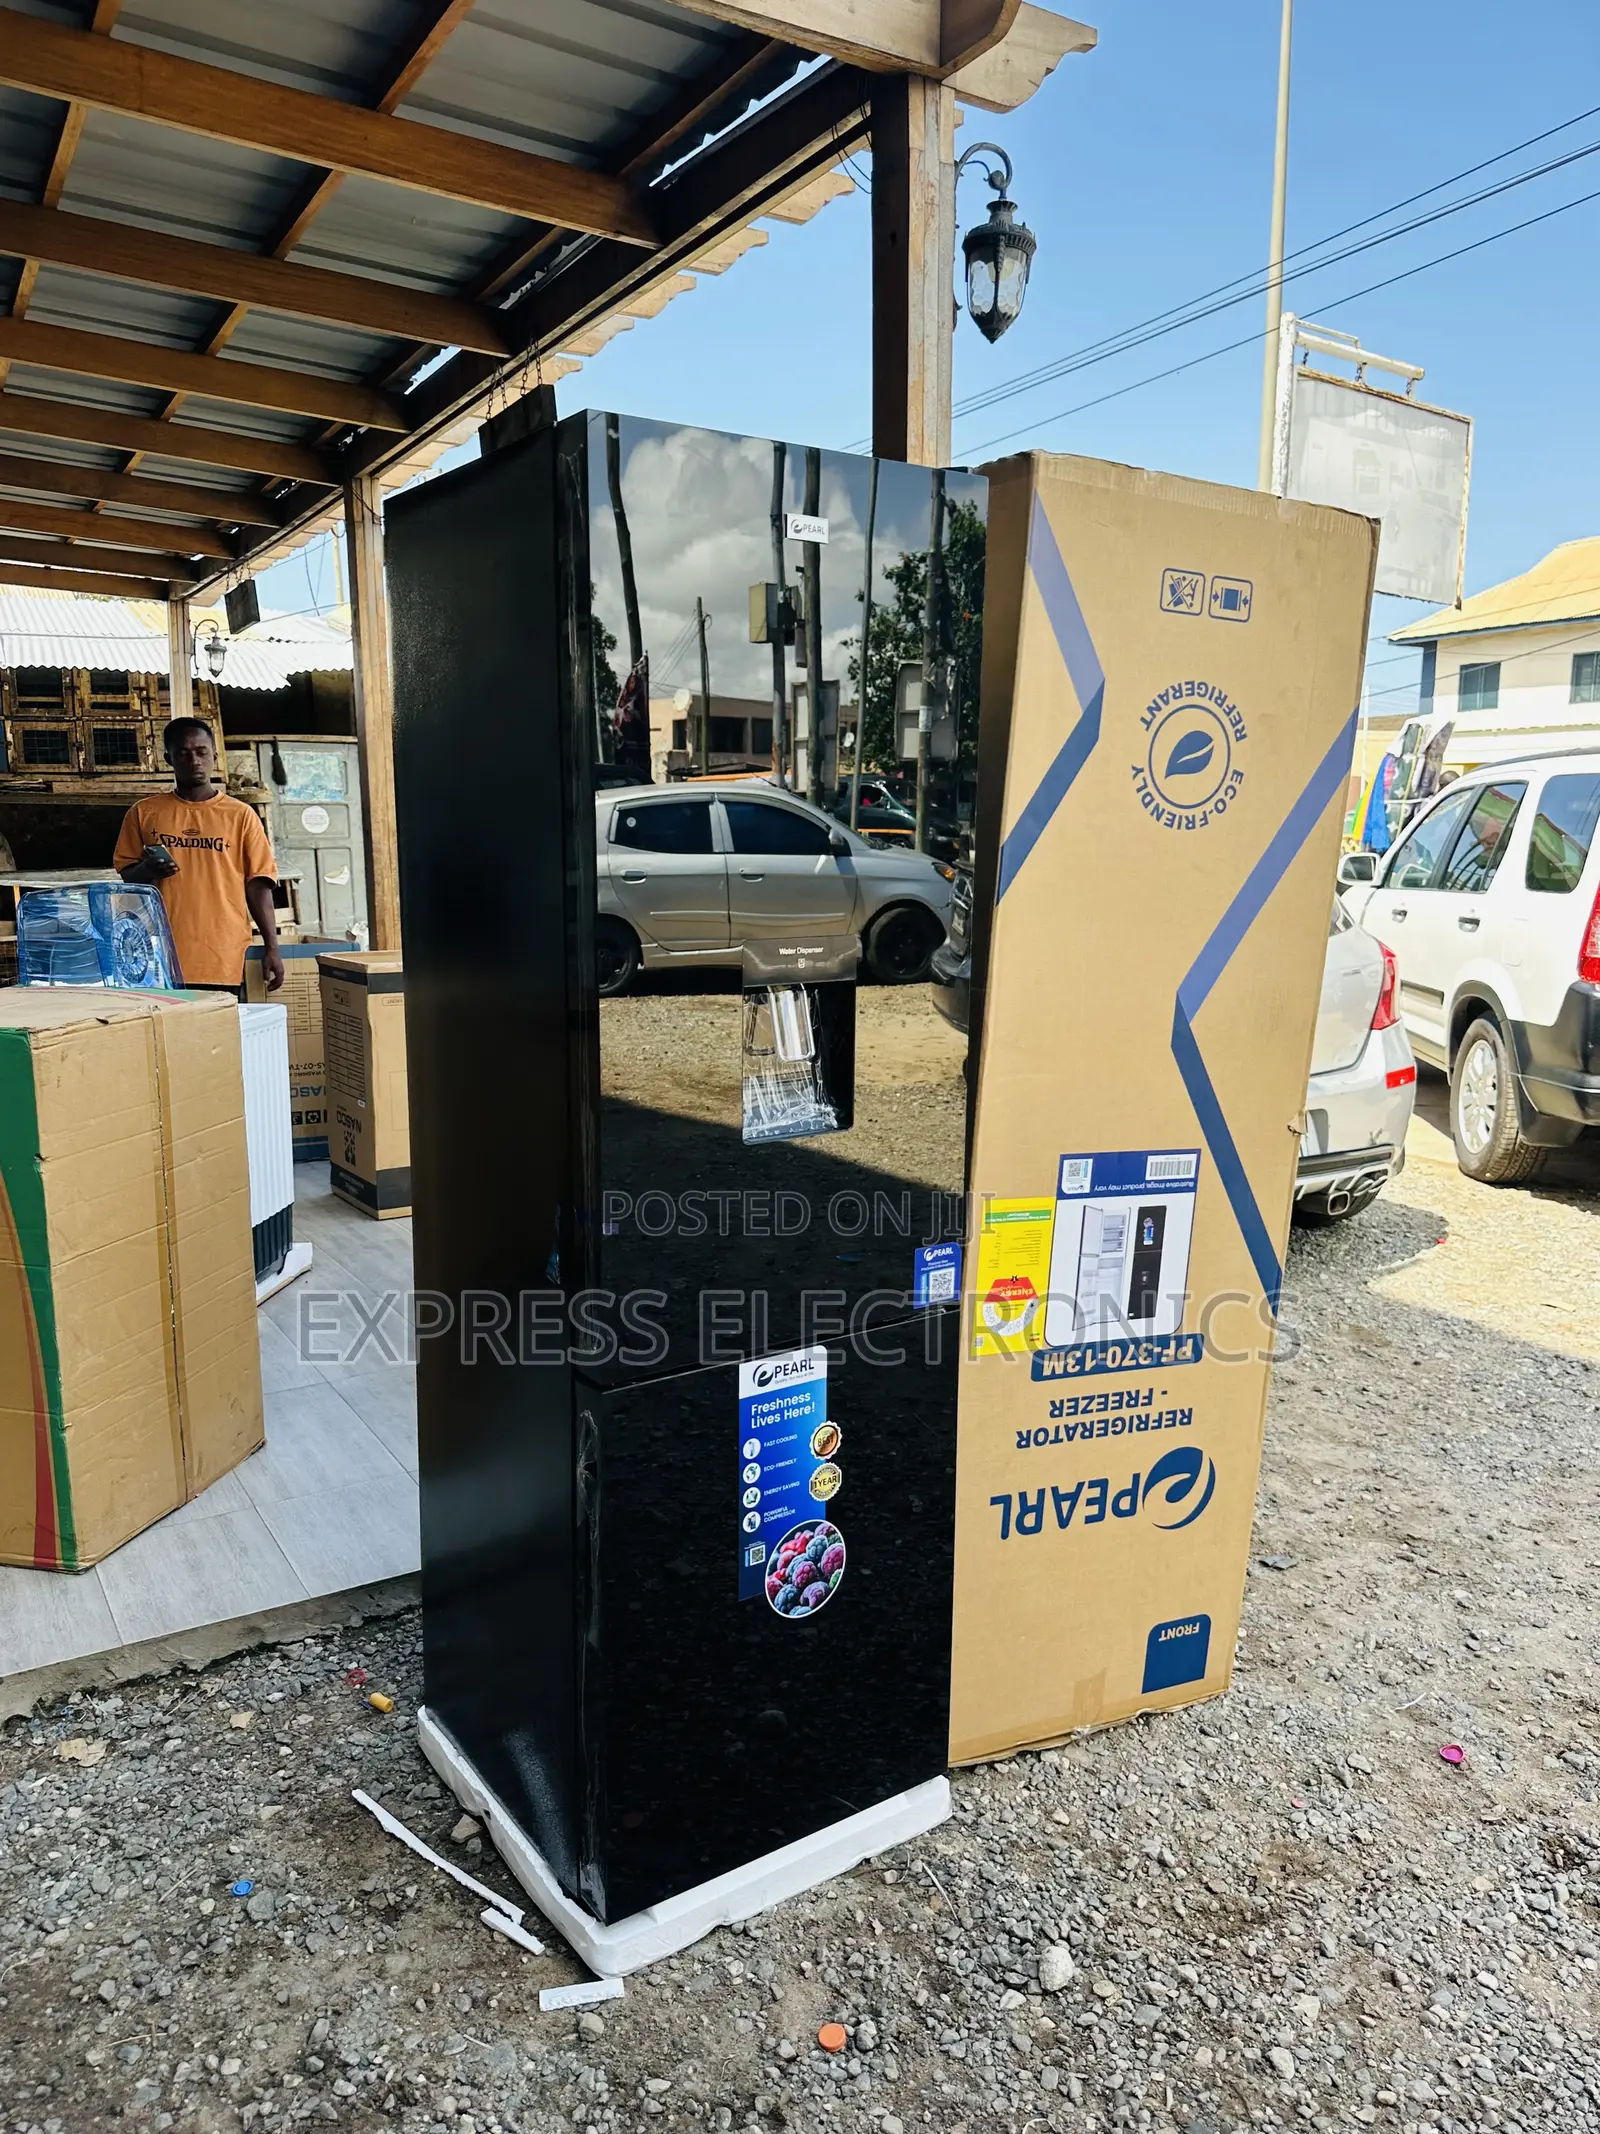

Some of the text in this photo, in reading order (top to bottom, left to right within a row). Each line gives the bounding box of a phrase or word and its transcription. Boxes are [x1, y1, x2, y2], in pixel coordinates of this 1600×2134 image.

[1139, 680, 1248, 743] REFRIGERANT
[1131, 764, 1244, 831] ECO-FRIENDLY
[779, 946, 824, 955] Water Dispenser
[336, 1110, 362, 1134] NASCO
[1042, 1338, 1194, 1377] PF-370-13M
[751, 1392, 811, 1416] Freshness
[751, 1401, 815, 1429] Lives Here!
[1049, 1387, 1154, 1419] FREEZER
[1016, 1407, 1193, 1449] REFRIGERATOR
[763, 1433, 798, 1448] FAST COOLING
[763, 1458, 797, 1472] ECO-FRIENDLY
[763, 1480, 800, 1496] ENERGY SAVING
[763, 1506, 788, 1517] POWERFUL
[763, 1508, 796, 1523] COMPRESSOR
[1158, 1622, 1200, 1642] FRONT
